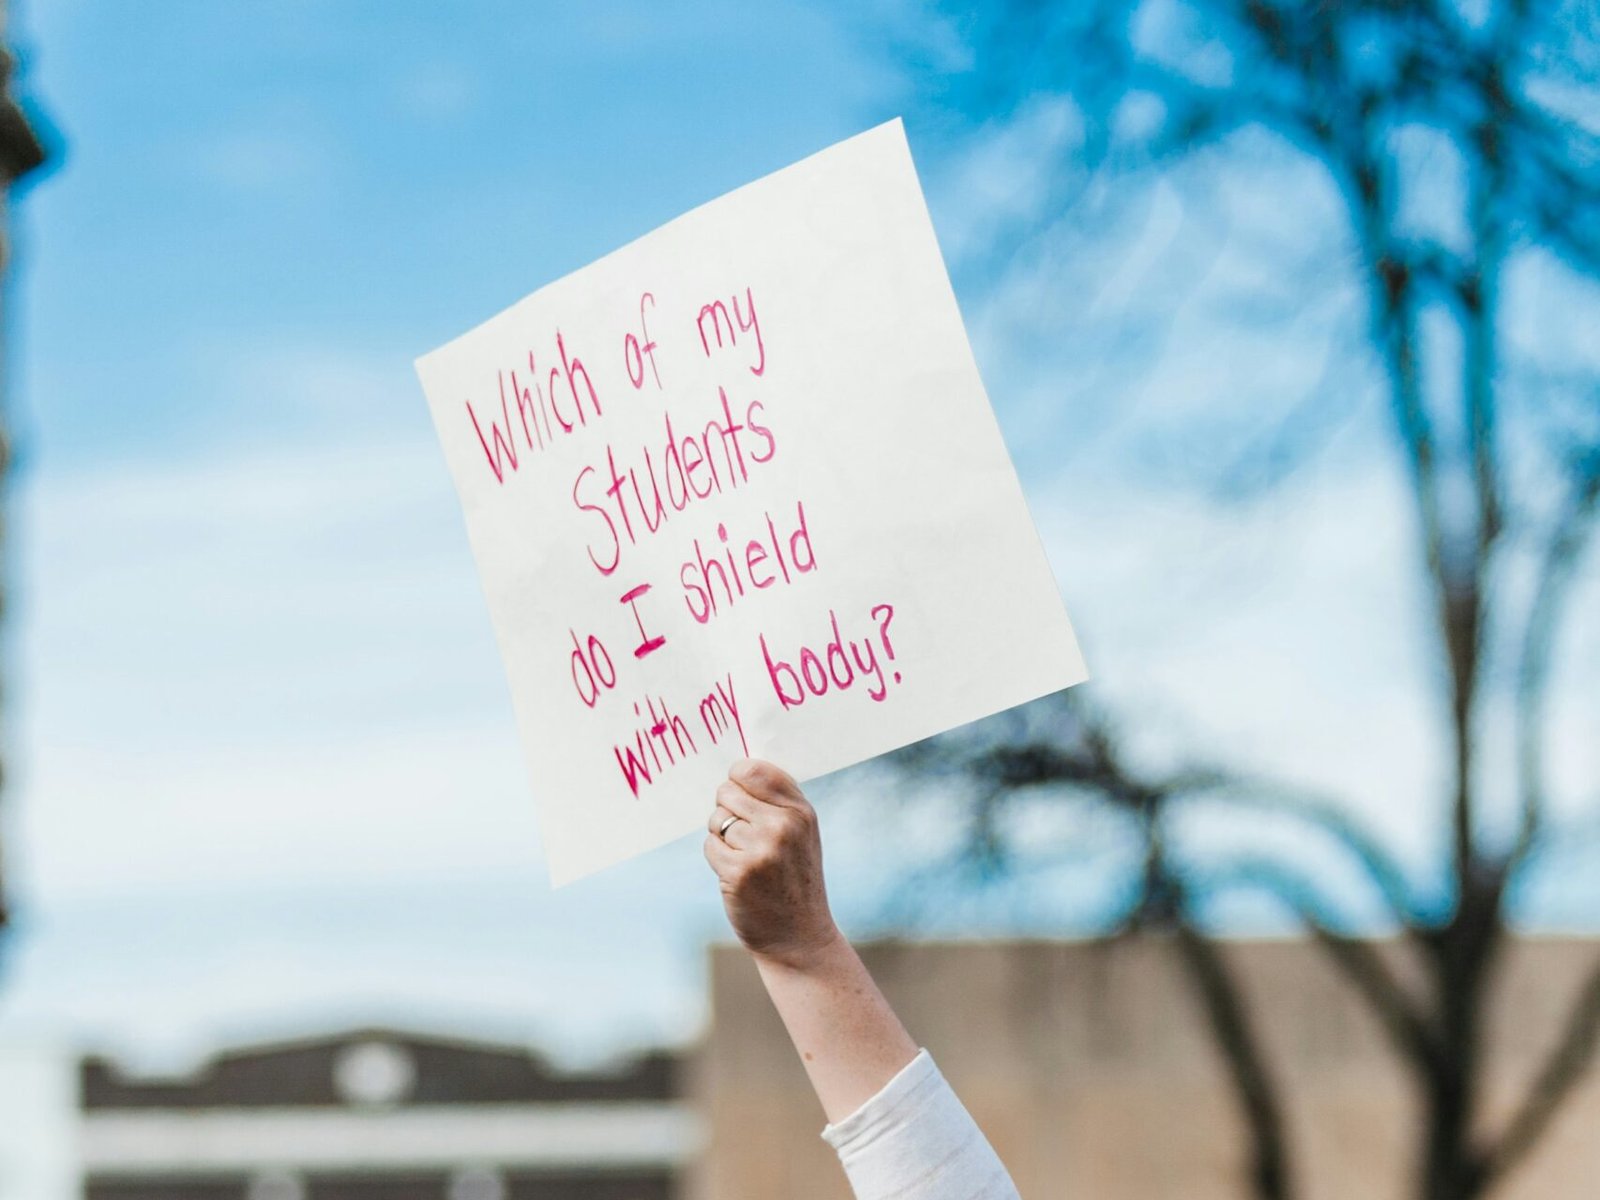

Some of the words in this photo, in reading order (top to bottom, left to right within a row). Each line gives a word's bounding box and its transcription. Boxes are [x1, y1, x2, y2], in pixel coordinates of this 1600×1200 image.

[466, 326, 602, 485] Which
[625, 292, 662, 390] of
[697, 287, 765, 377] my
[573, 386, 776, 576] Students
[570, 628, 616, 708] do
[620, 583, 667, 659] I
[681, 501, 817, 624] shield
[614, 694, 698, 800] with
[699, 673, 750, 760] my
[759, 603, 903, 711] body?
